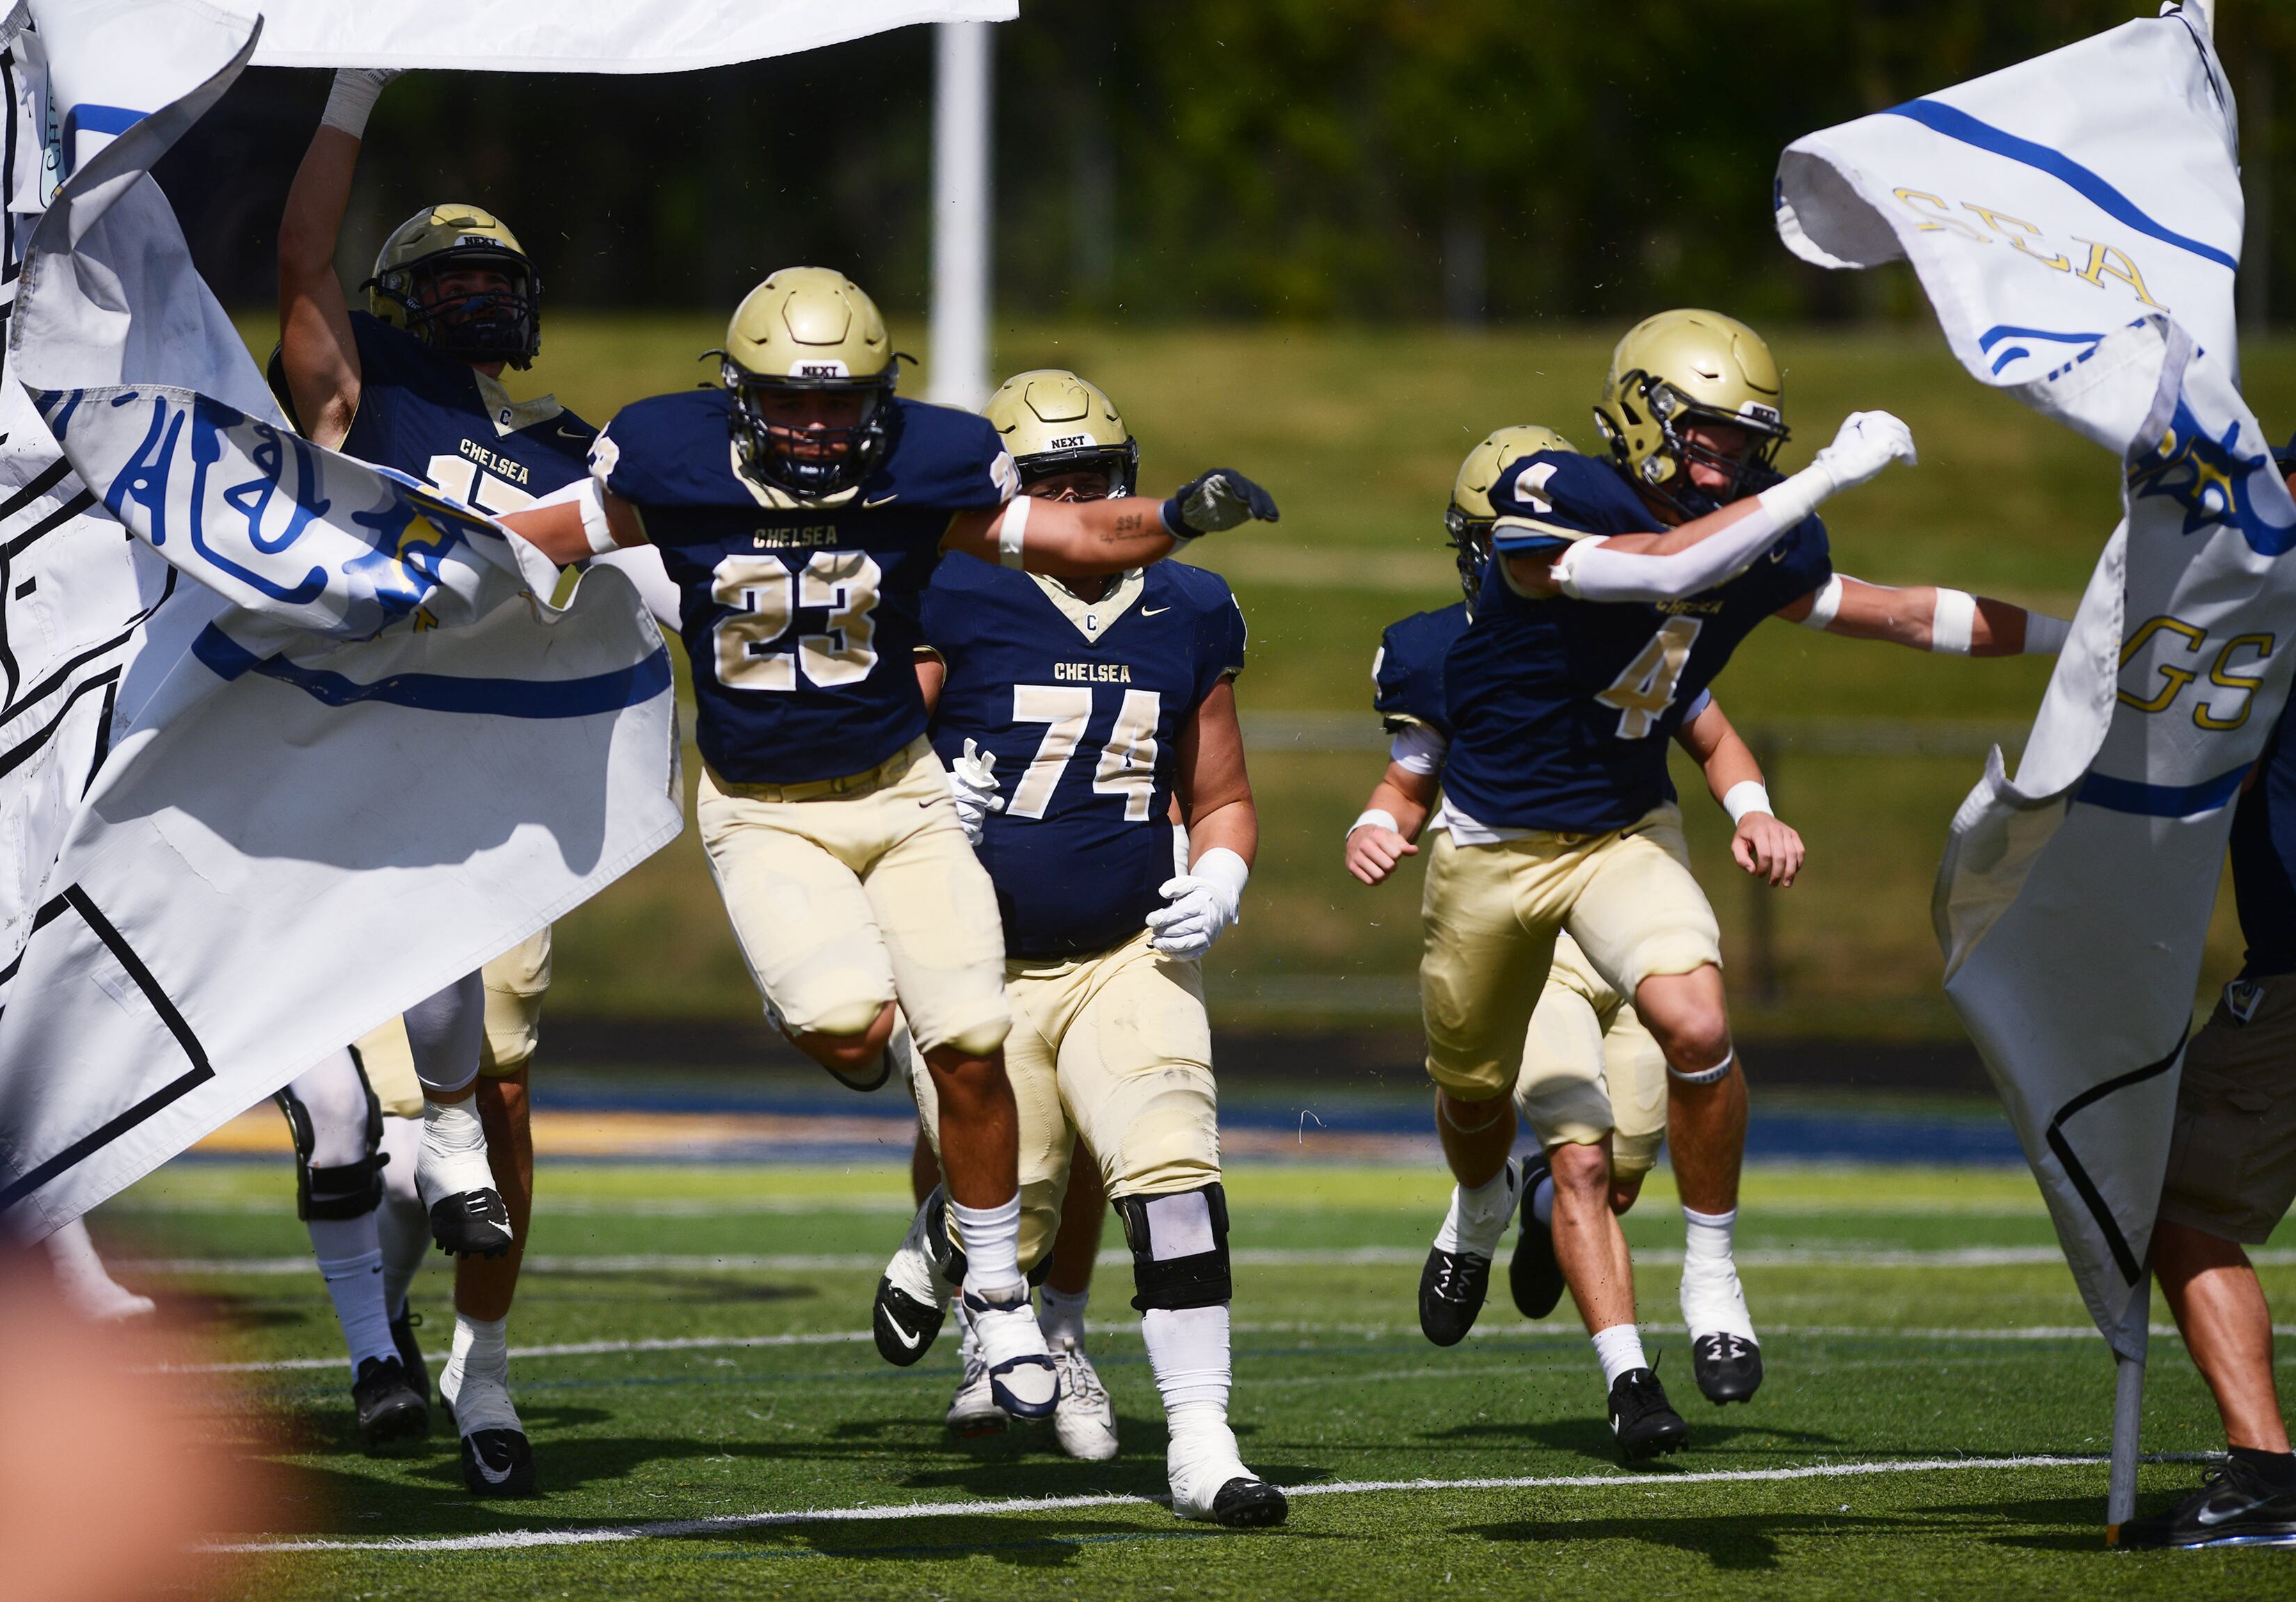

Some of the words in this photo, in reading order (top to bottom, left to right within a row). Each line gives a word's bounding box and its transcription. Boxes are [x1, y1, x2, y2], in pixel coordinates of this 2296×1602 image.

[464, 236, 497, 246] NEXT
[1892, 187, 2171, 314] SEA
[802, 366, 838, 378] NEXT
[499, 407, 512, 426] C
[1051, 435, 1085, 449] NEXT
[459, 438, 529, 485] CHELSEA
[753, 525, 838, 549] CHELSEA
[711, 550, 882, 692] 23
[1085, 613, 1099, 632] C
[1054, 662, 1131, 683] CHELSEA
[1594, 614, 1703, 740] 4
[1005, 683, 1161, 822] 74
